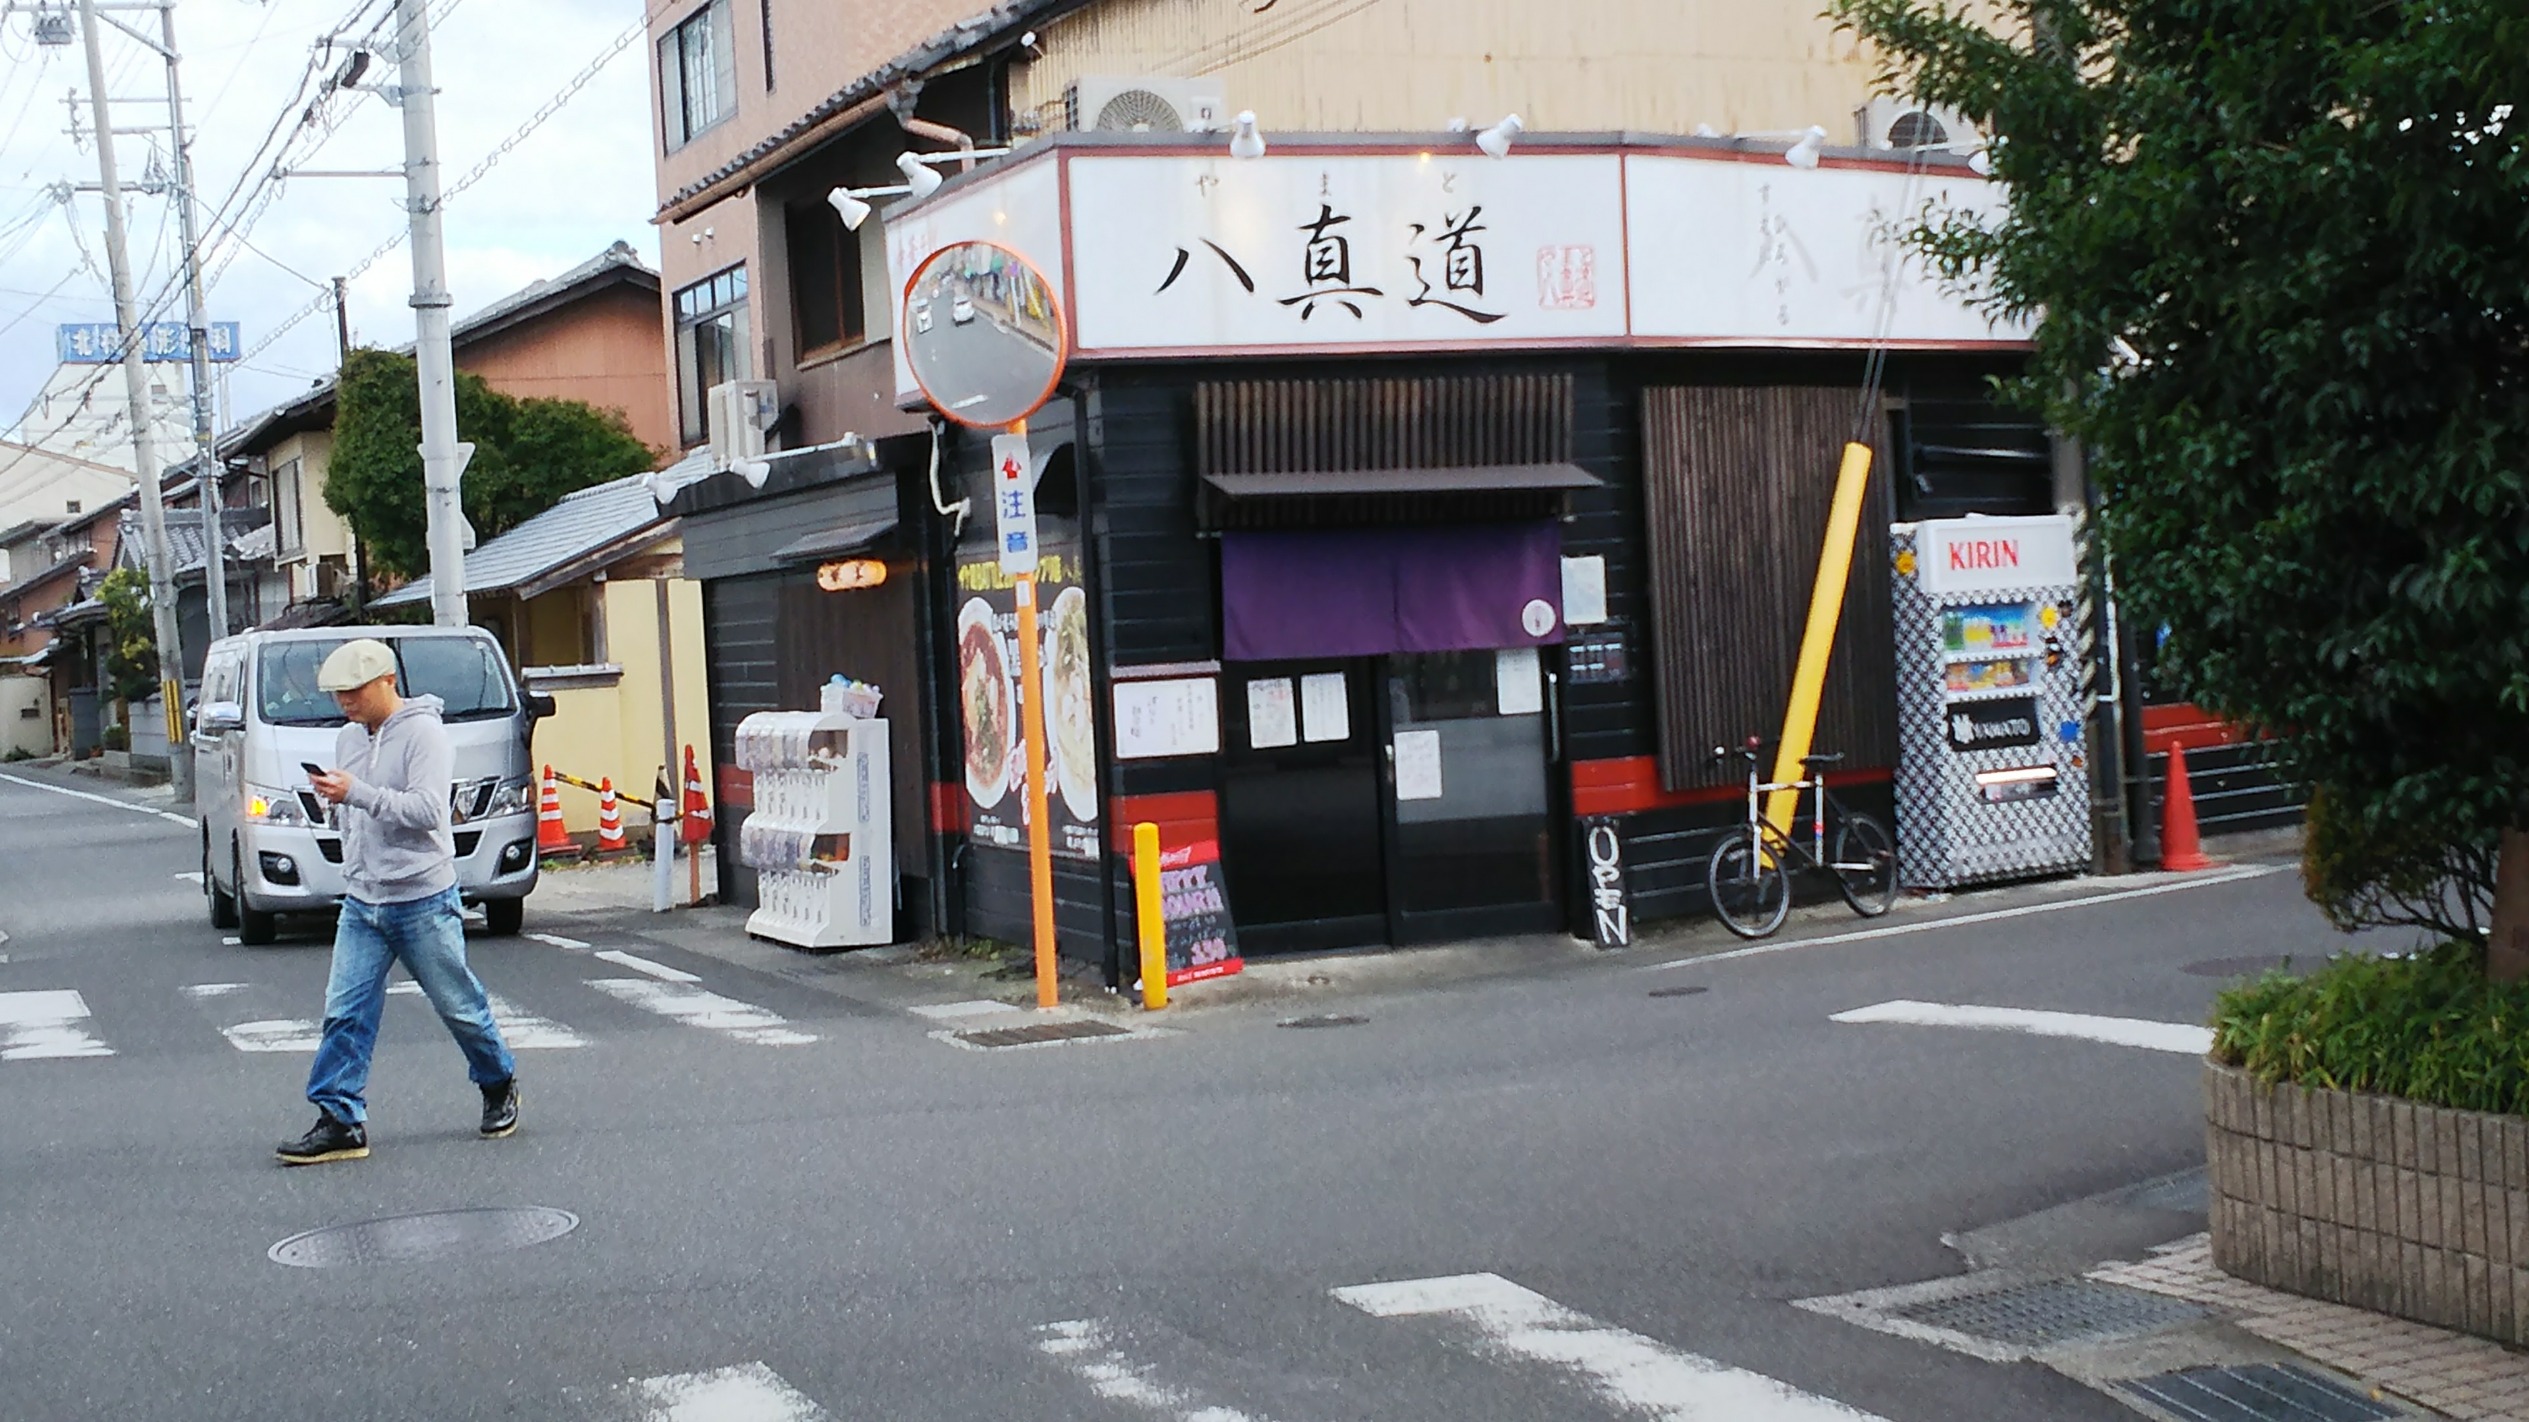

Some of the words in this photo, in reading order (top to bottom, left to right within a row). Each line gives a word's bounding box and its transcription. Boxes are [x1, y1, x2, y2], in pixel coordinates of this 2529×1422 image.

[1154, 203, 1509, 324] 八真道
[1002, 490, 1029, 554] 注意
[1949, 540, 2018, 571] KIRIN
[1588, 826, 1627, 945] OPEN
